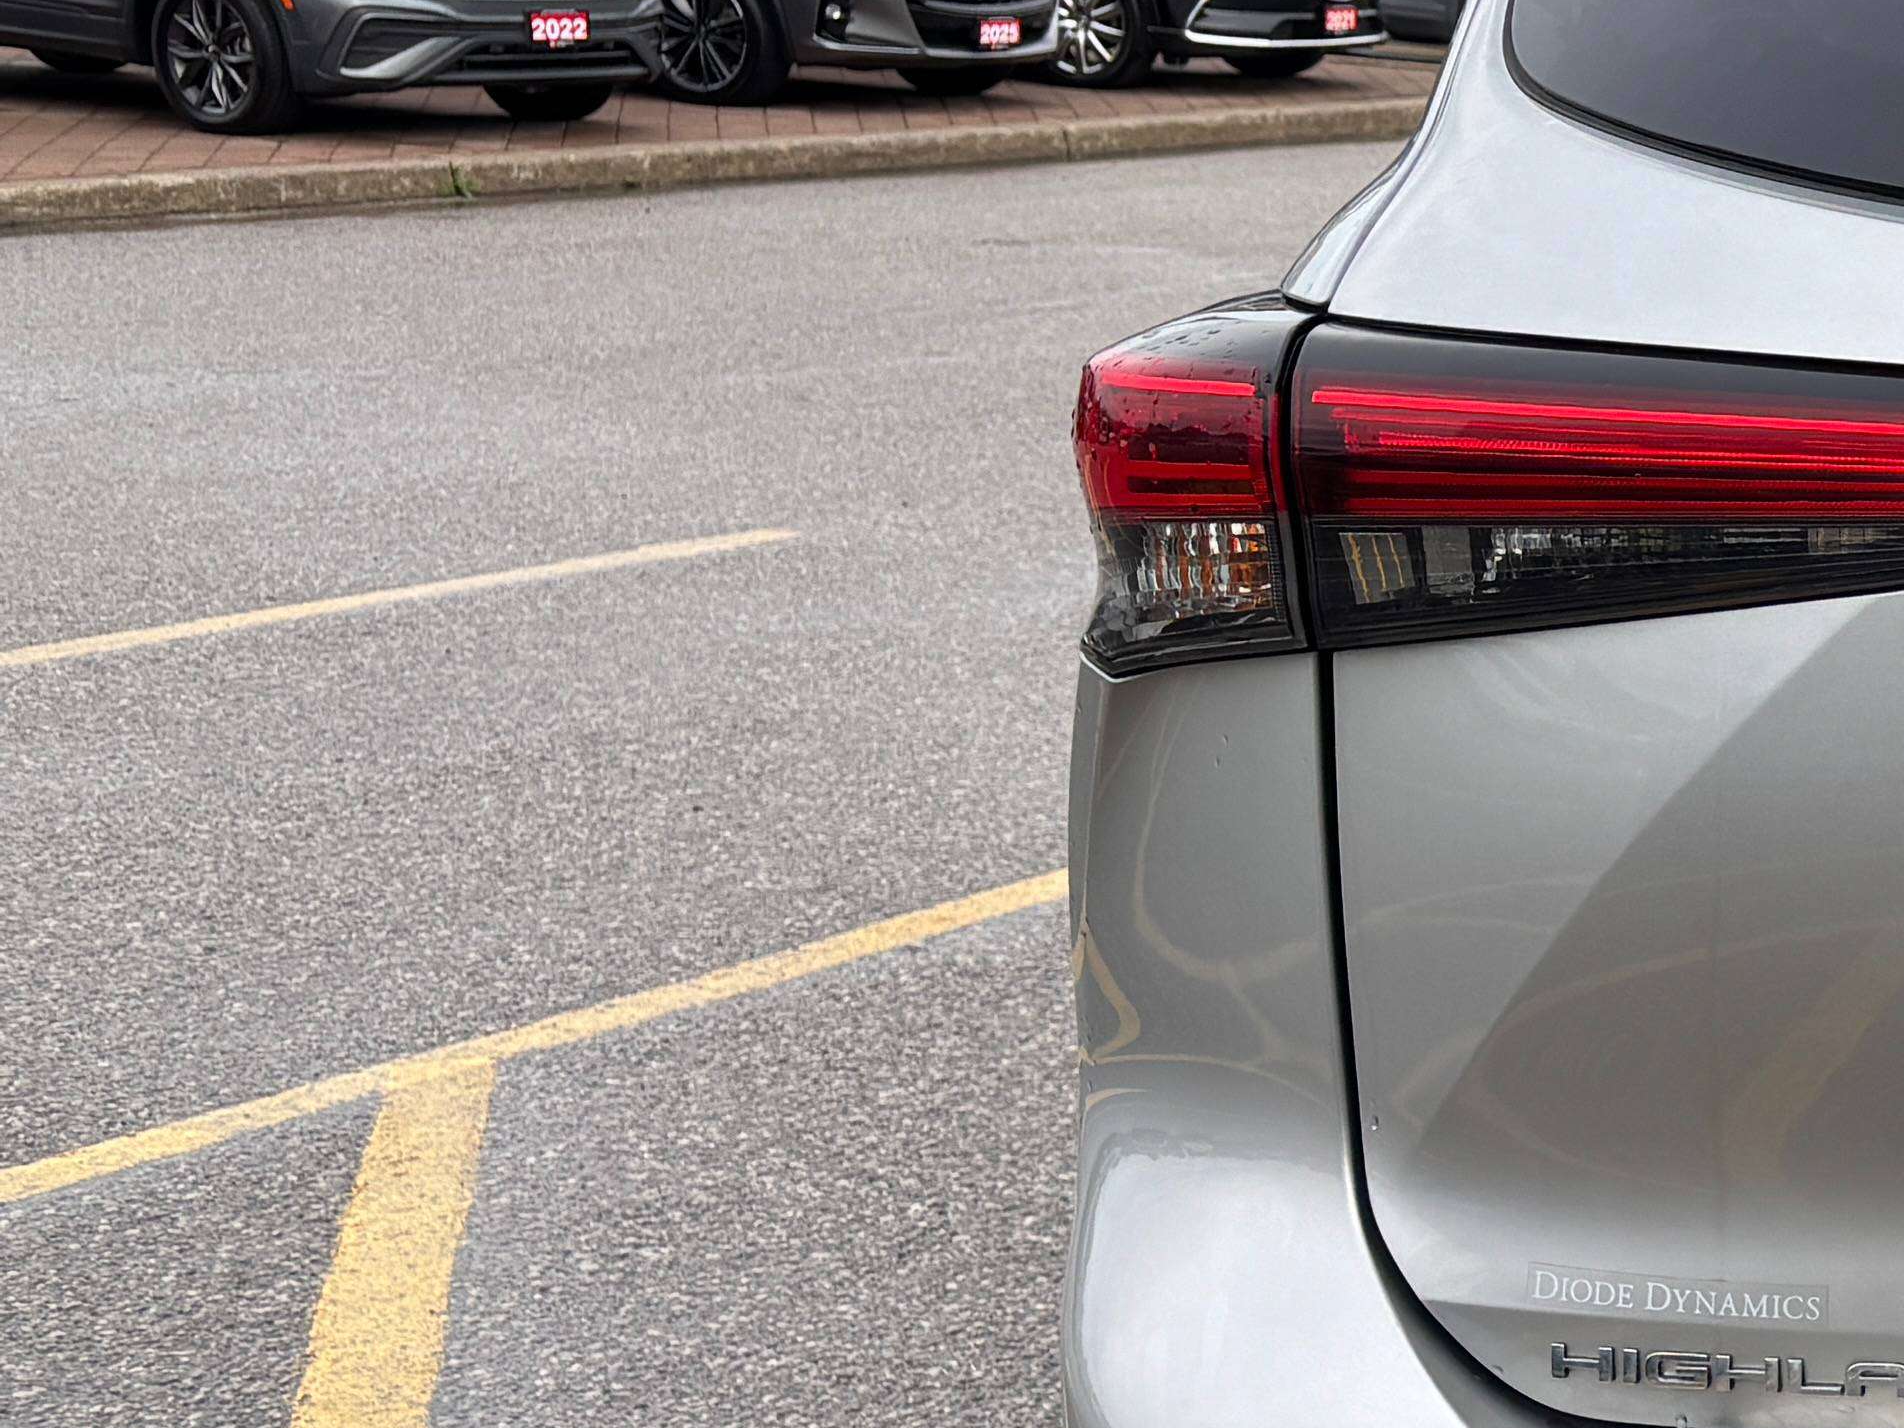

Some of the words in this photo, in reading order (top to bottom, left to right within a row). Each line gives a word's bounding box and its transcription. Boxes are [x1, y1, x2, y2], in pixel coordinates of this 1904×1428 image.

[531, 17, 588, 41] 2022
[1531, 1269, 1635, 1310] DIODE
[1645, 1282, 1822, 1321] DYNAMICS
